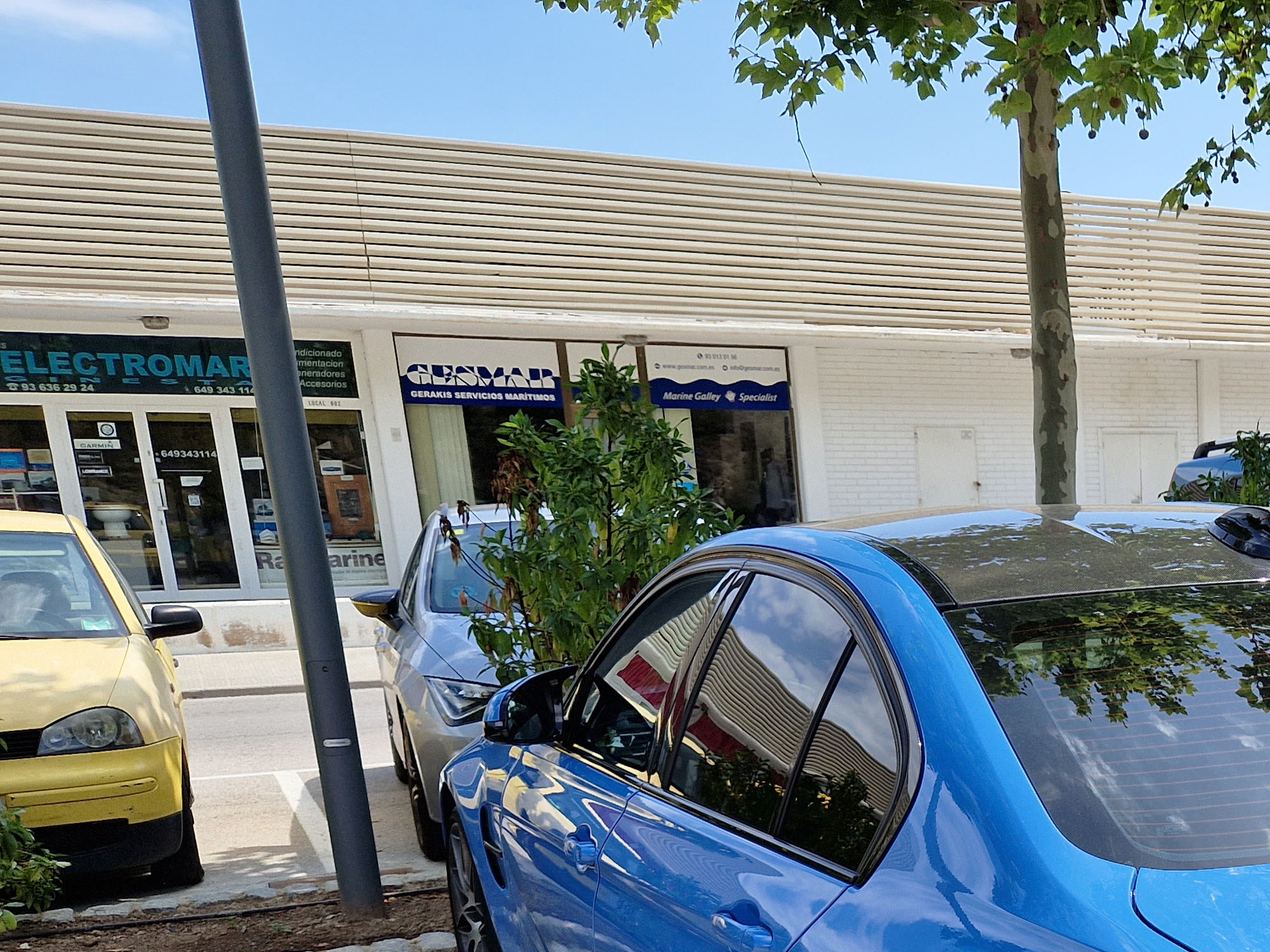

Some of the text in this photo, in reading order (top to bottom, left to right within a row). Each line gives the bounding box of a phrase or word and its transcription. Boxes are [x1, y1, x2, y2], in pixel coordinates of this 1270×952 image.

[294, 349, 342, 357] ndicionado
[0, 350, 252, 377] ELECTROMAR
[296, 360, 344, 368] mentacion
[298, 370, 346, 378] neradores
[406, 363, 556, 389] GESMAR
[21, 383, 95, 392] 93 636 29 24
[300, 379, 348, 389] Accesorios
[194, 386, 214, 394] 649
[216, 386, 236, 394] 343
[411, 390, 556, 402] GERAKIS SERVICIOS MARÍTIMOS
[663, 391, 778, 403] Marine Galley Specialist
[160, 449, 218, 458] 649343114
[255, 548, 386, 570] Raarine
